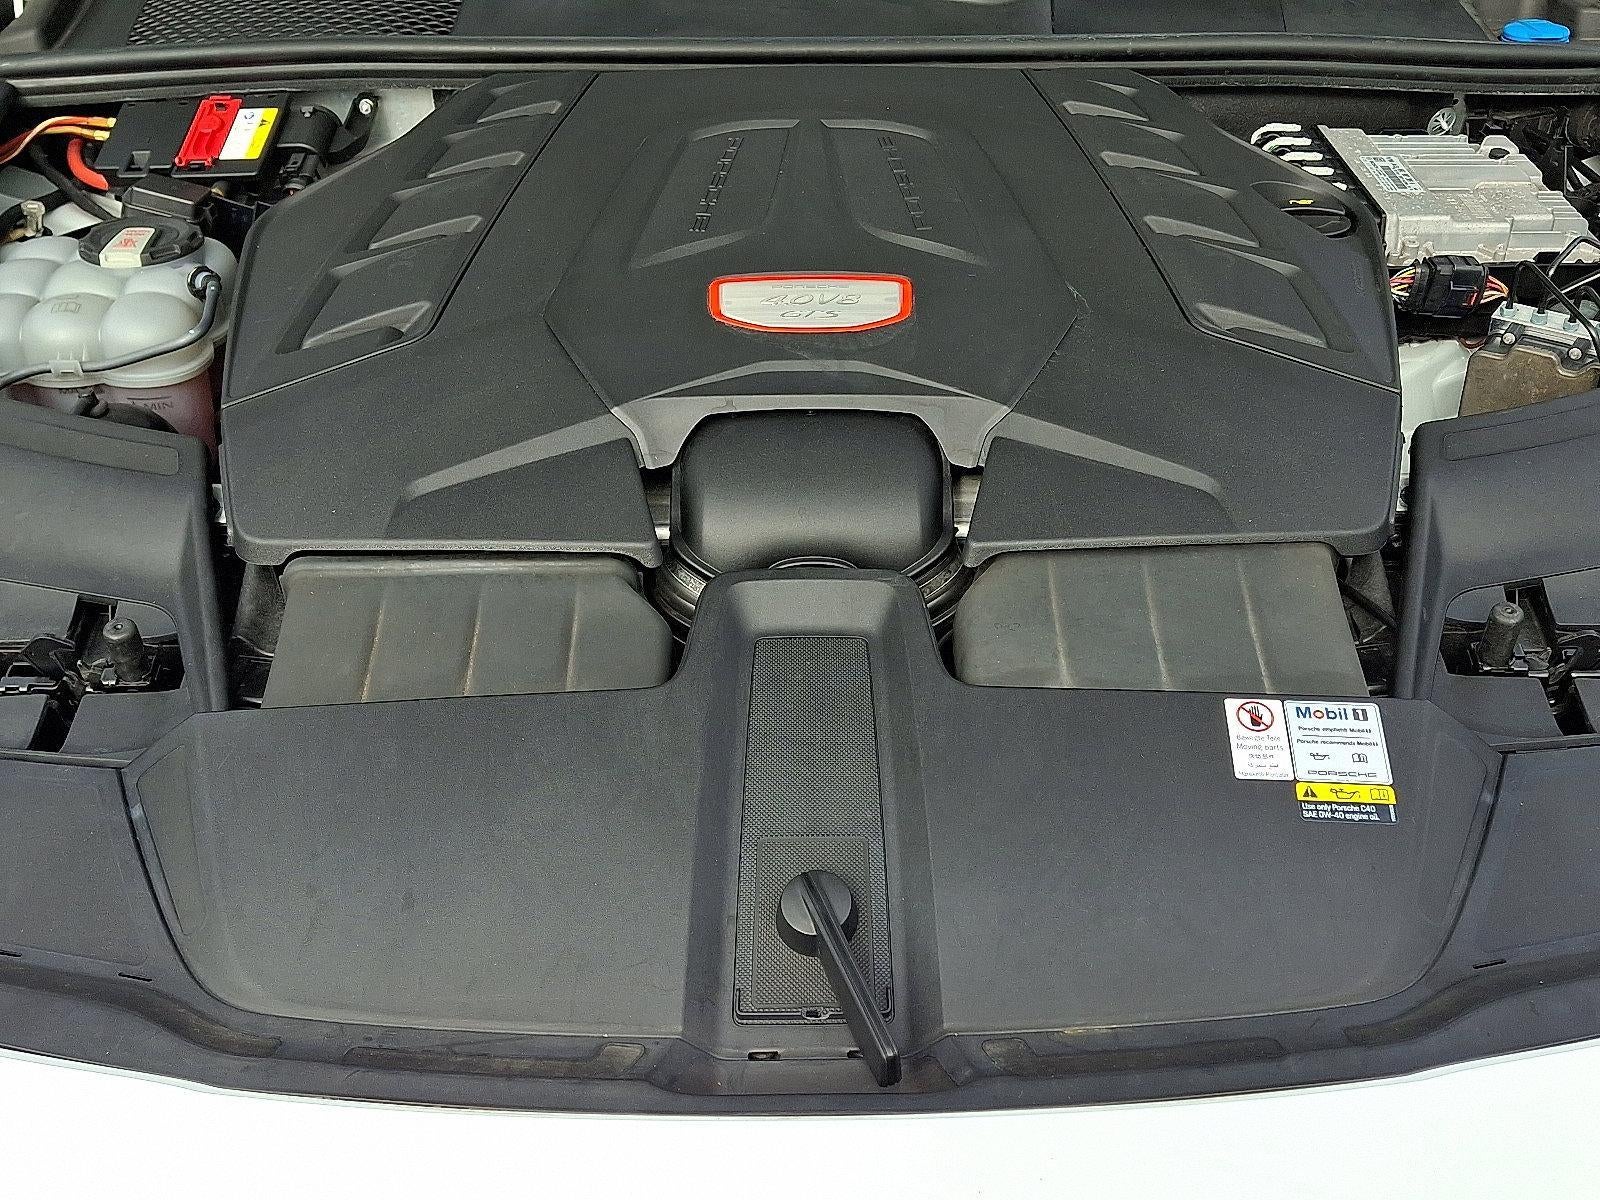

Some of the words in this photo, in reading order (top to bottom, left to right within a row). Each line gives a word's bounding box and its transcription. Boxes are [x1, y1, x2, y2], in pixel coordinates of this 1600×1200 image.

[689, 137, 744, 232] PORSCHE
[779, 310, 843, 318] GTS
[1296, 706, 1348, 720] Mobil
[1353, 709, 1367, 721] 1
[1236, 743, 1262, 751] Moving
[1319, 811, 1344, 819] 0W-40
[1345, 813, 1368, 821] engine
